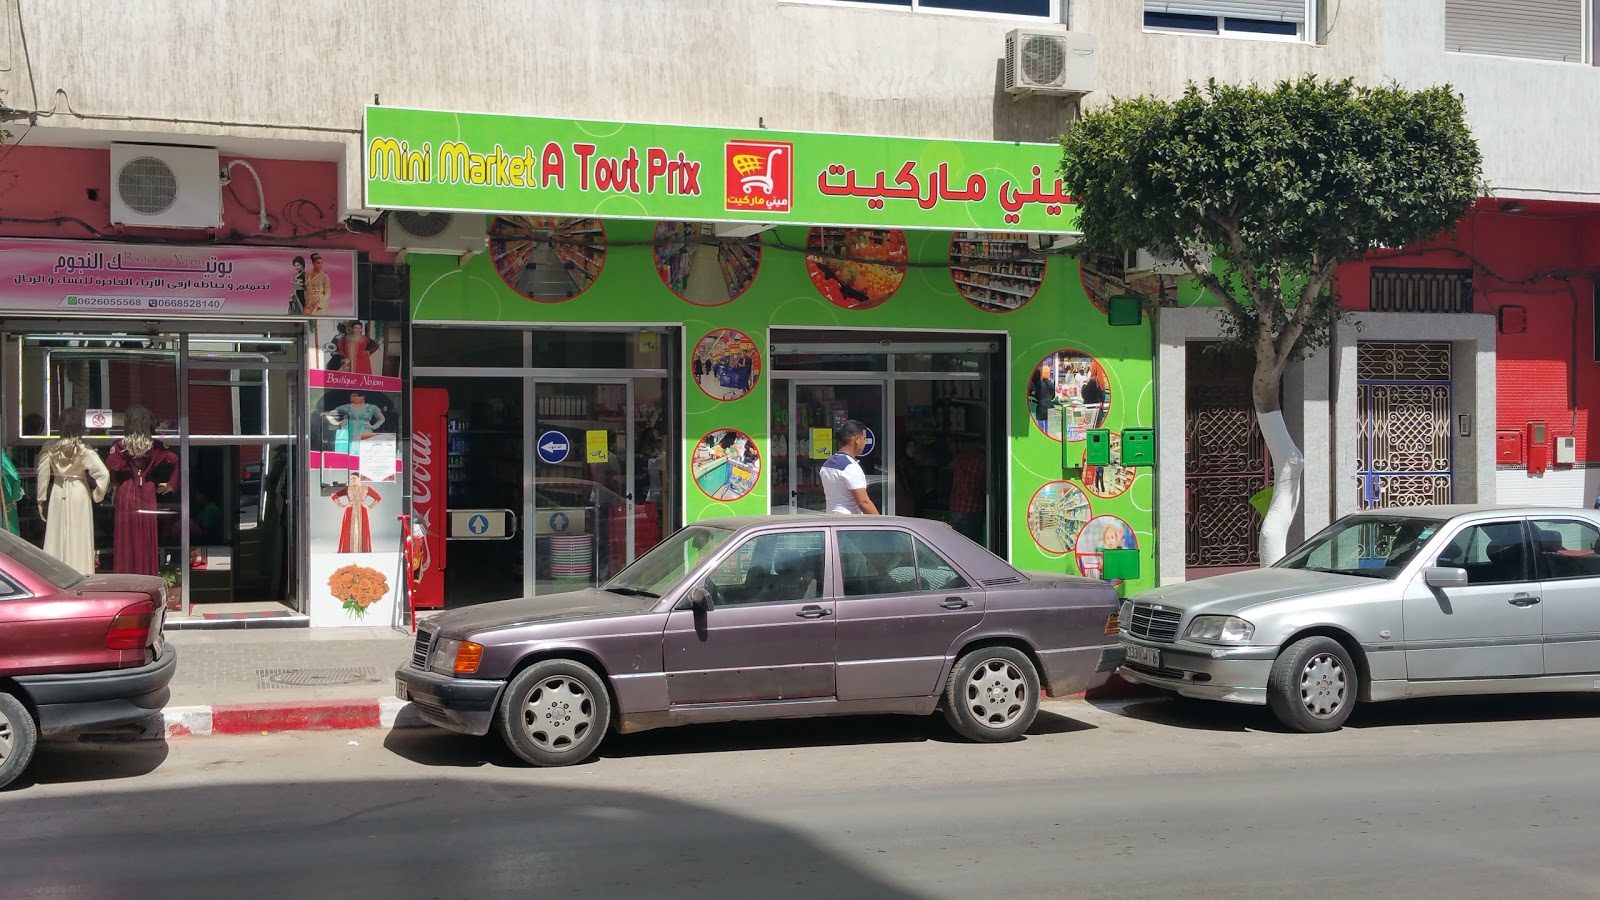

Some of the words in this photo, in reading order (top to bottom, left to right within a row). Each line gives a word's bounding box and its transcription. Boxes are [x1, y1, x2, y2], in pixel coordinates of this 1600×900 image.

[369, 137, 431, 183] Mini
[438, 141, 536, 188] Market
[541, 141, 565, 190] A
[572, 143, 641, 193] Tout
[647, 148, 701, 195] Prix
[818, 161, 987, 209] ماركيت
[727, 195, 765, 207] ماركيت
[766, 196, 788, 209] ميني
[1000, 166, 1085, 224] يني
[54, 252, 103, 274] النجوم
[78, 298, 142, 307] 0626055568
[158, 299, 220, 308] 0668528140
[326, 373, 358, 387] Boutique
